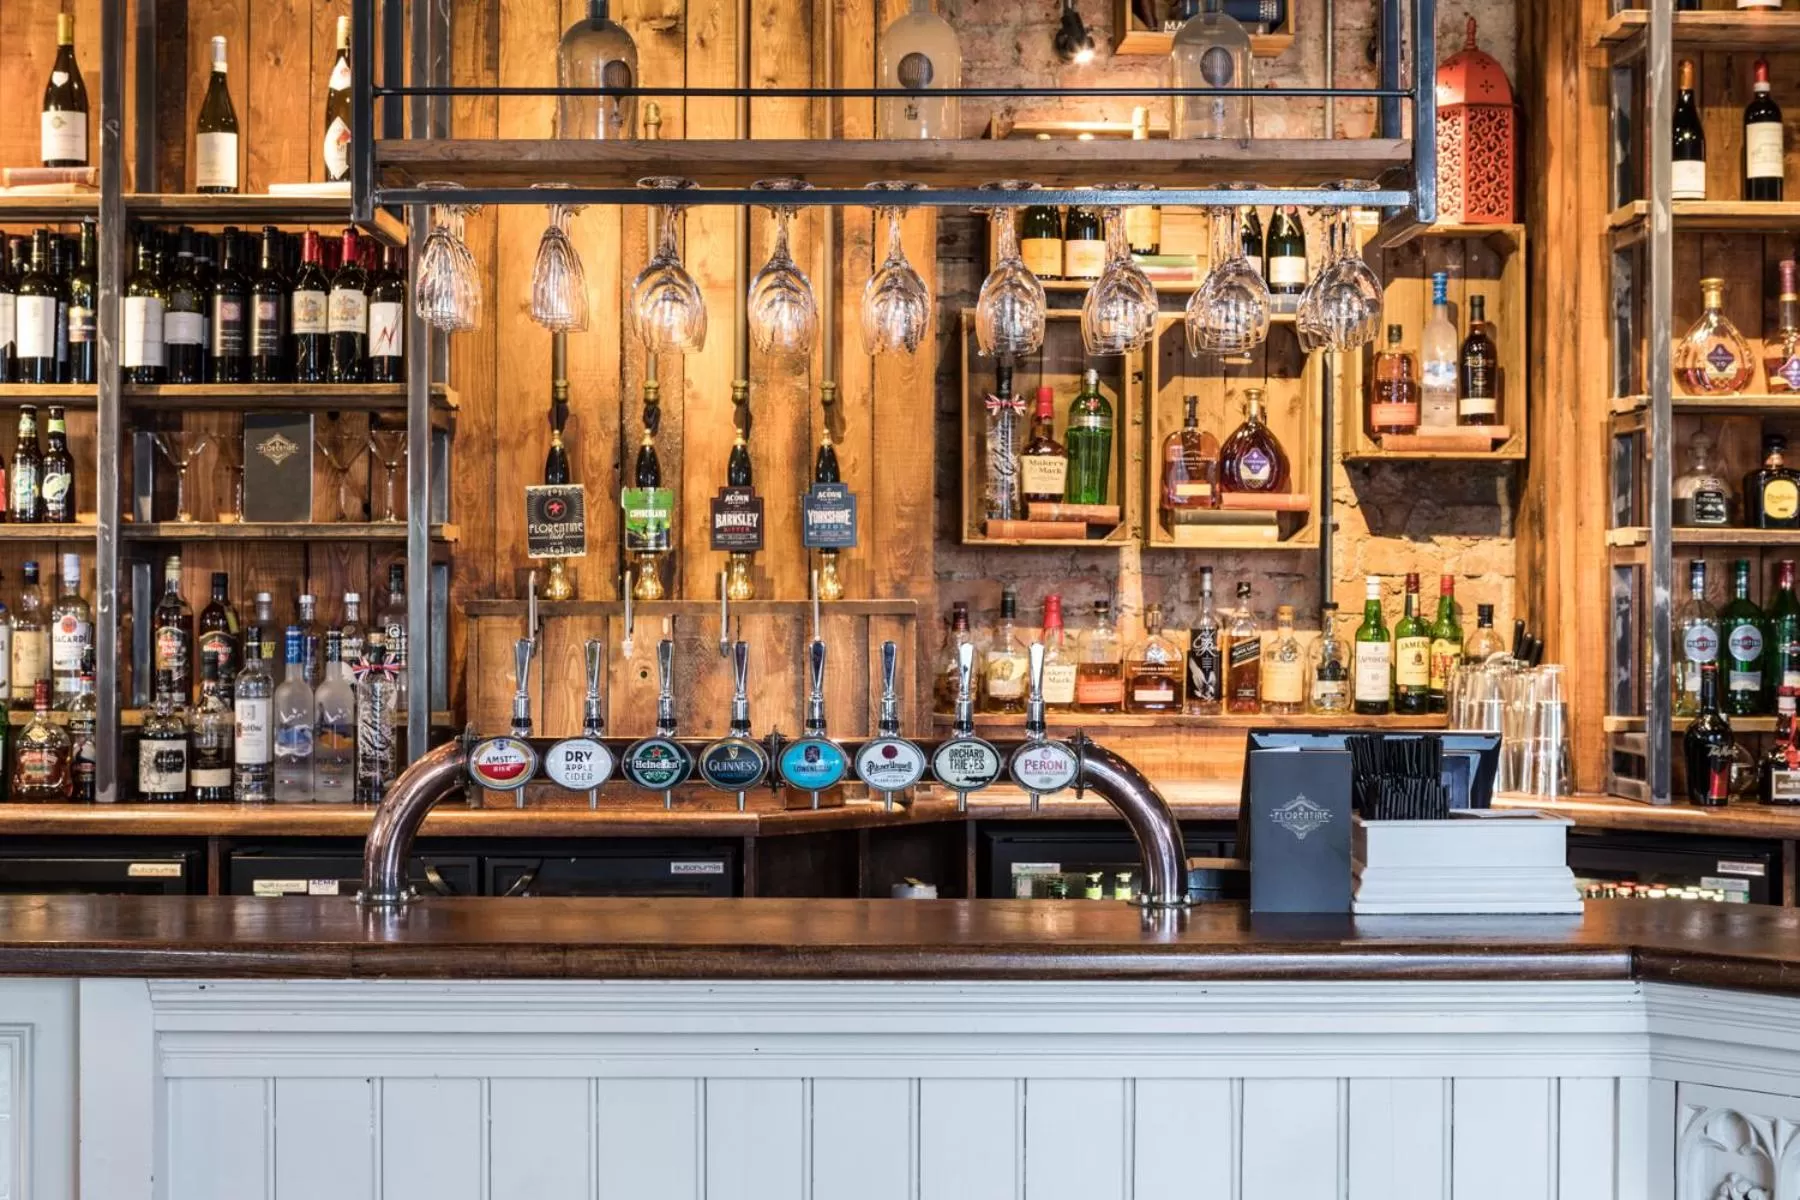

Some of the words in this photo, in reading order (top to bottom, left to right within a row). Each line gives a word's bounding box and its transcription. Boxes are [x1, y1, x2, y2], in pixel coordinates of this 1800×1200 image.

[1029, 459, 1064, 467] Maker's
[1039, 467, 1063, 475] Mark
[724, 494, 750, 502] ACORN
[817, 491, 842, 499] ACORN
[565, 751, 593, 762] DRY
[948, 749, 985, 758] ORCHARD
[564, 764, 593, 772] APPLE
[635, 759, 680, 769] Heineken
[708, 760, 758, 772] GUINNESS
[949, 760, 985, 770] THIEVES
[1024, 759, 1068, 771] PERONI
[564, 773, 593, 781] CIDER
[1273, 811, 1329, 820] FLORENTINE
